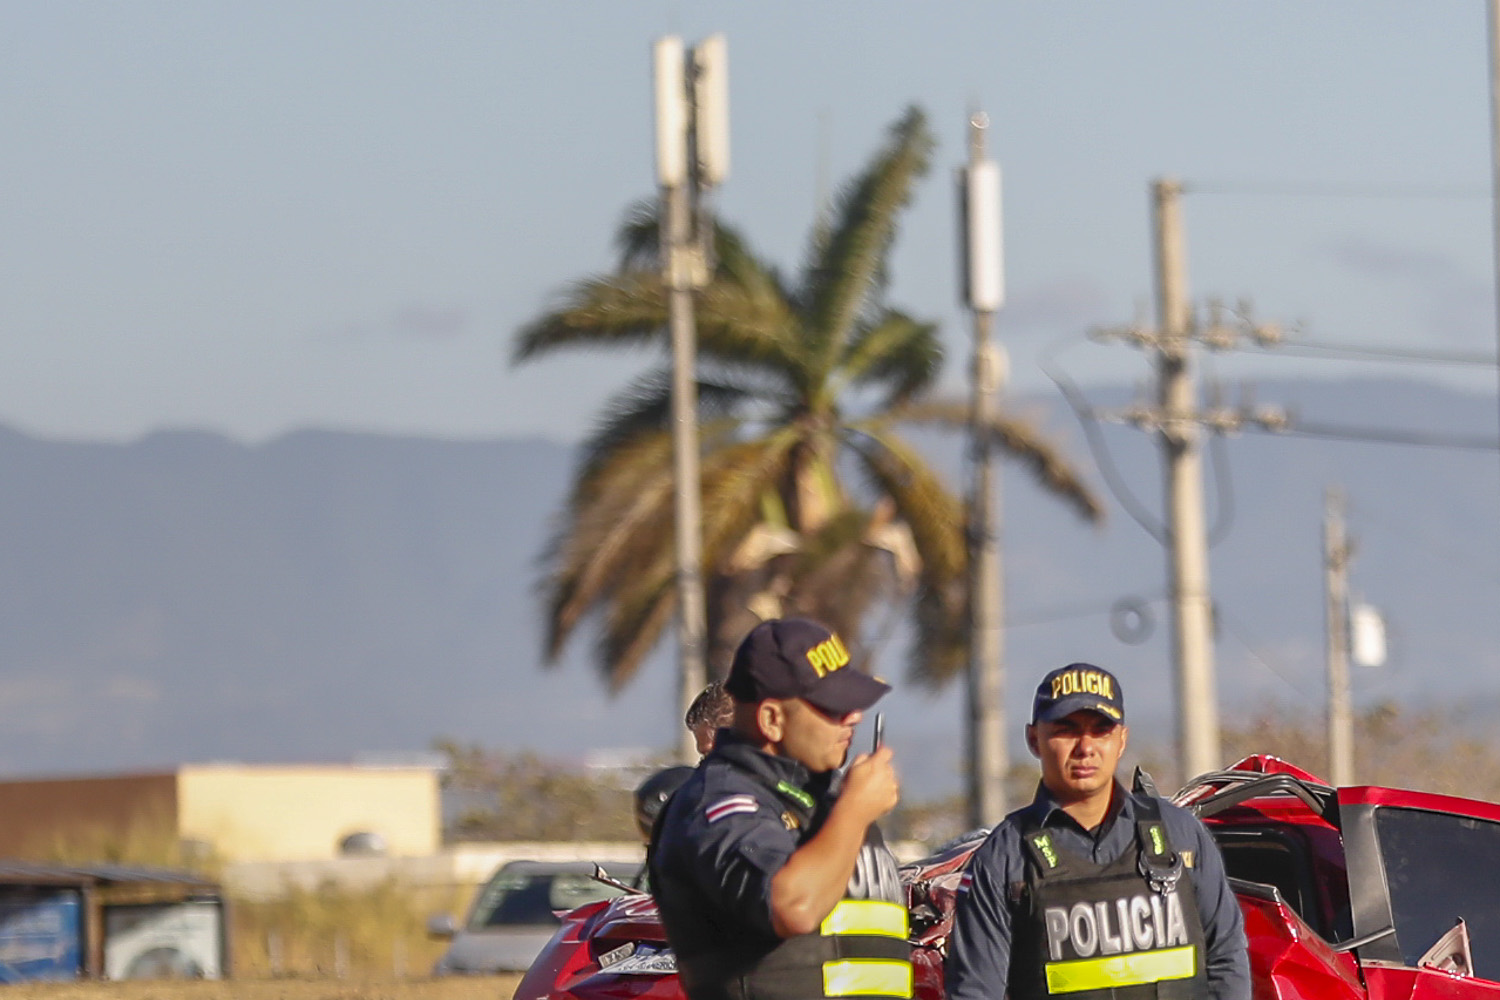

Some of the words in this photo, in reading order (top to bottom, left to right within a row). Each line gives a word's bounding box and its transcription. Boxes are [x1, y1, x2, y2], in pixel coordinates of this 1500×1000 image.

[1051, 668, 1114, 701] POLICIA
[1033, 834, 1059, 869] MSP
[1045, 891, 1189, 961] POLICIA
